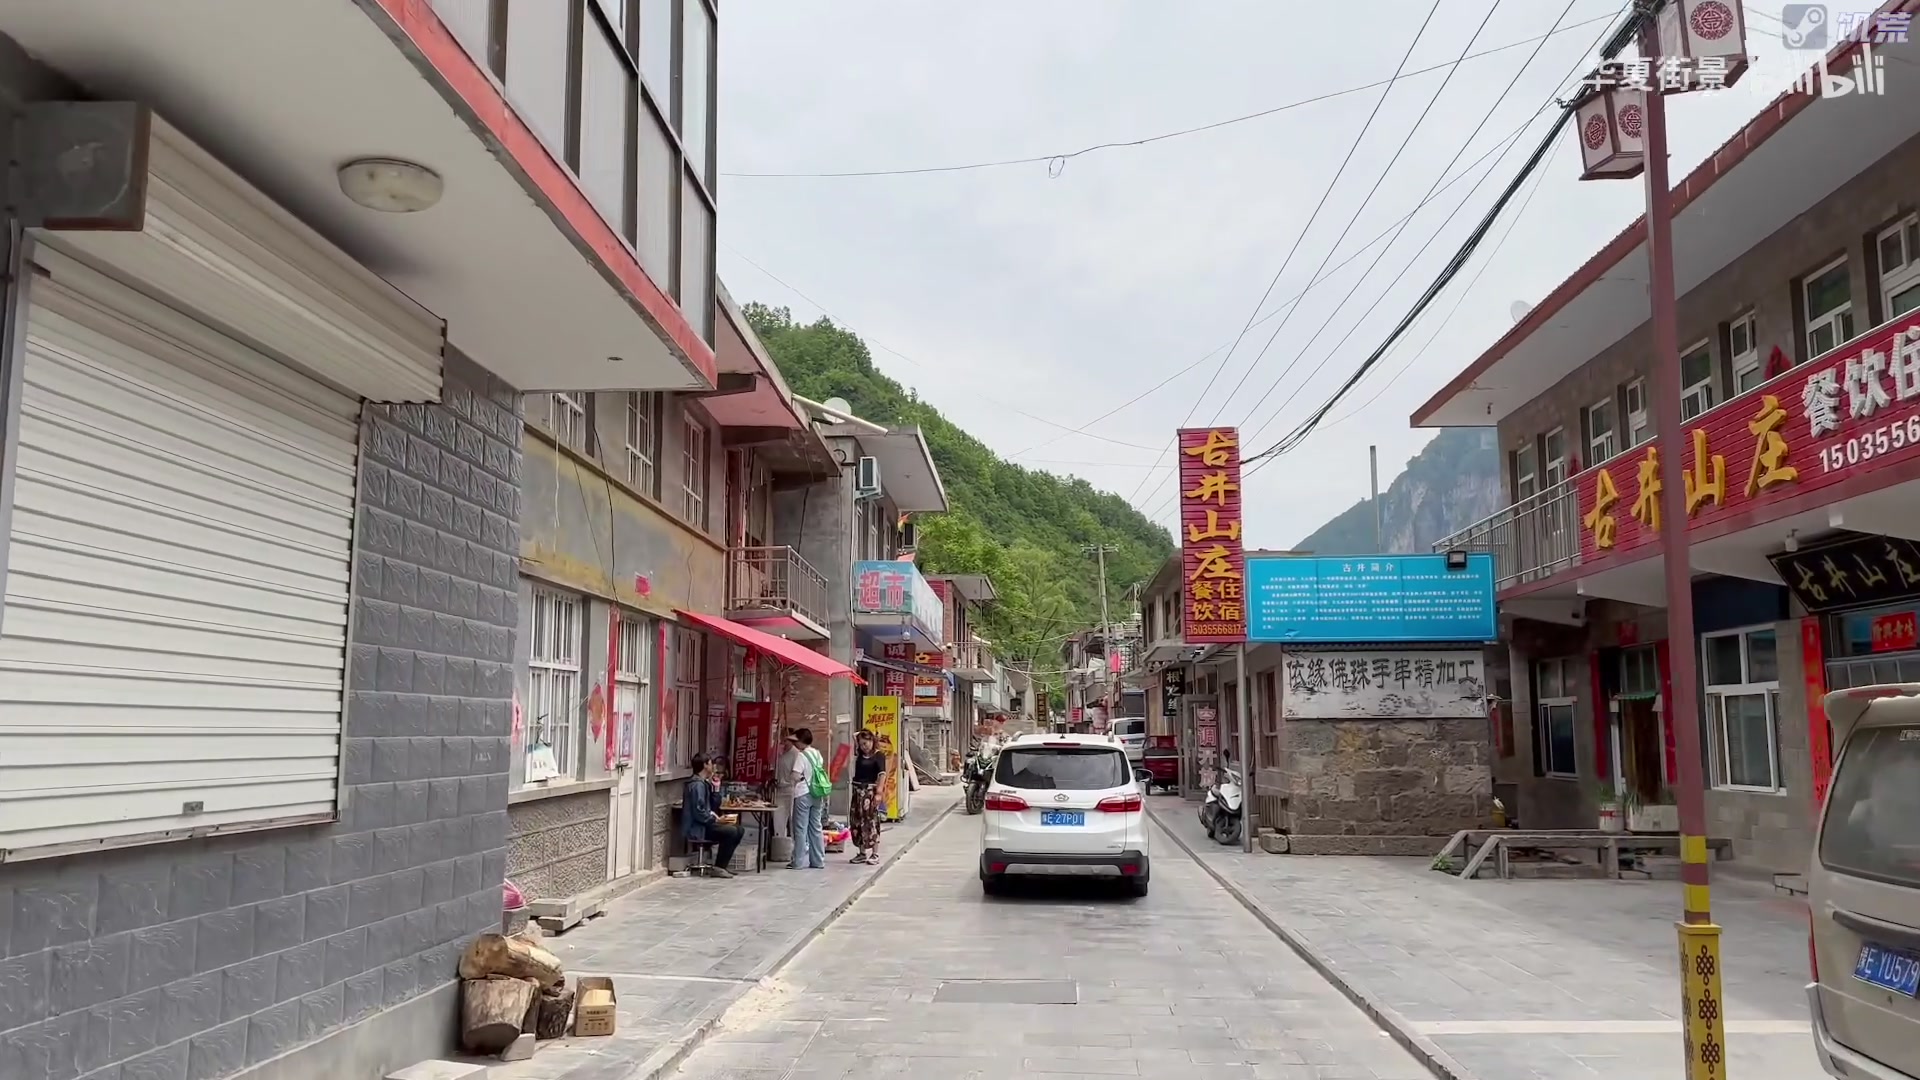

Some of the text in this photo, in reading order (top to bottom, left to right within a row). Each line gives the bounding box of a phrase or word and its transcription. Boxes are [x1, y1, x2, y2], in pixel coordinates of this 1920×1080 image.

[1584, 395, 1799, 550] 古井山庄
[1819, 415, 1920, 473] 1503556
[1184, 429, 1241, 580] 古井山庄
[859, 570, 905, 609] 超市
[885, 644, 906, 696] 诚超市
[1197, 706, 1218, 789] 空调开放
